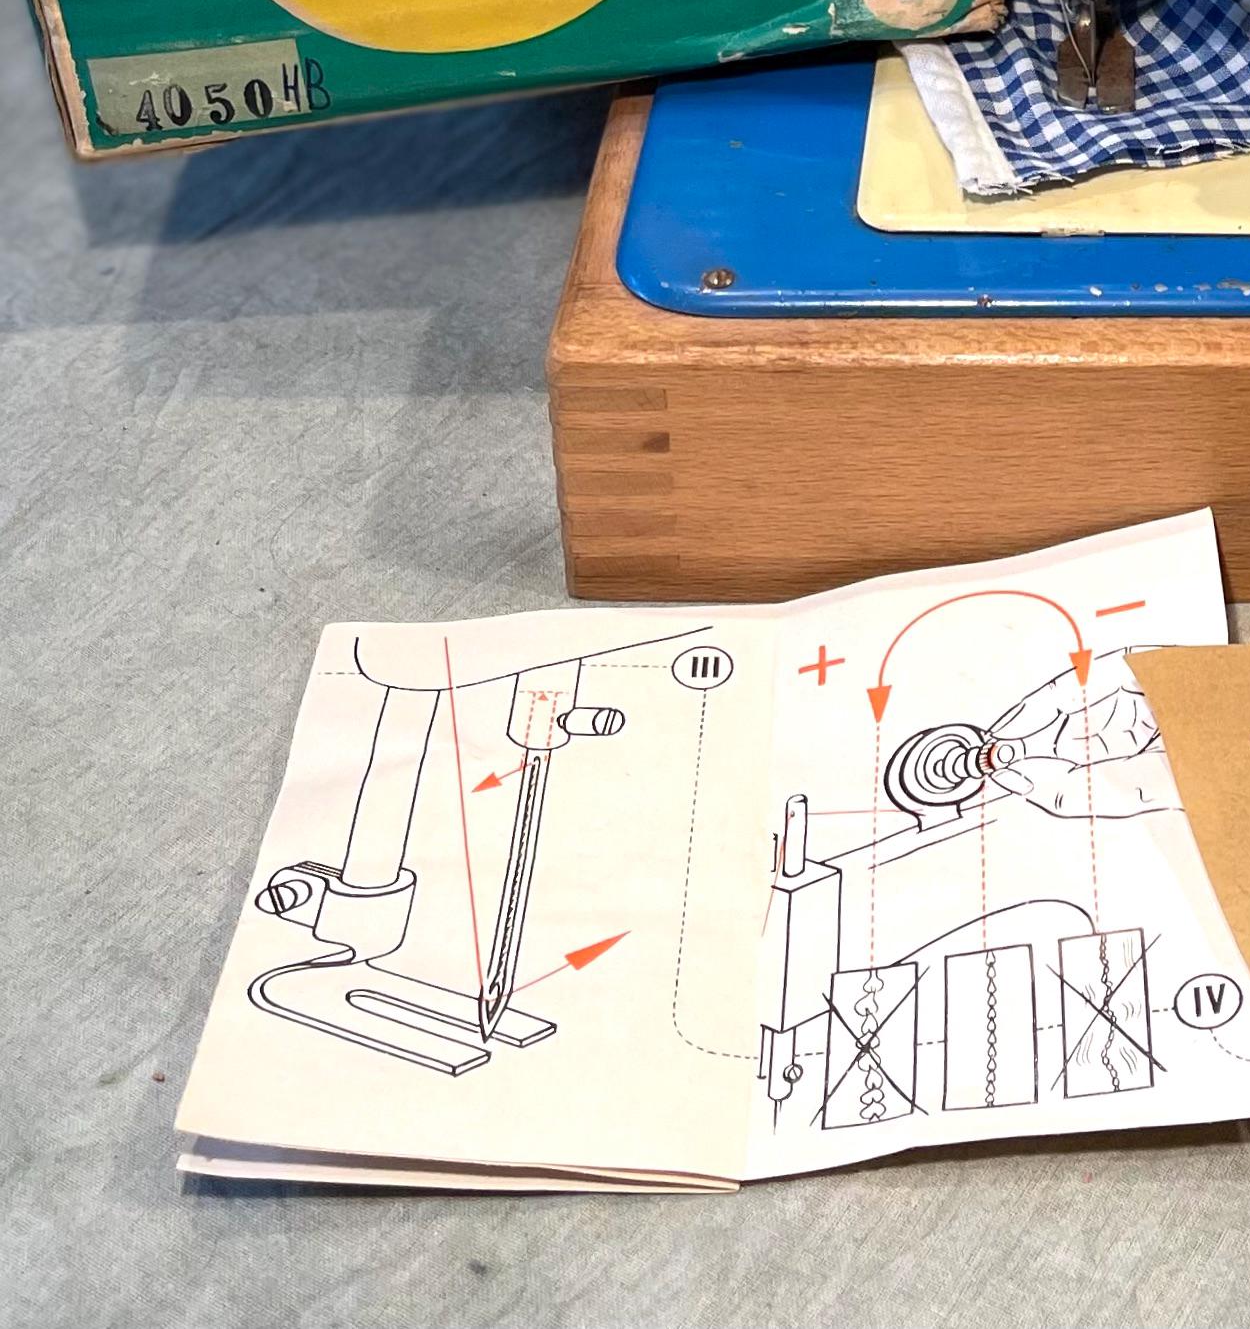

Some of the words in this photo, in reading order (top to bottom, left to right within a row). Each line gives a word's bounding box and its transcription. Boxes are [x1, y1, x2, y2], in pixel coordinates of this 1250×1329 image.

[136, 78, 273, 131] 4050
[691, 656, 720, 678] III
[1193, 982, 1226, 1018] IV
